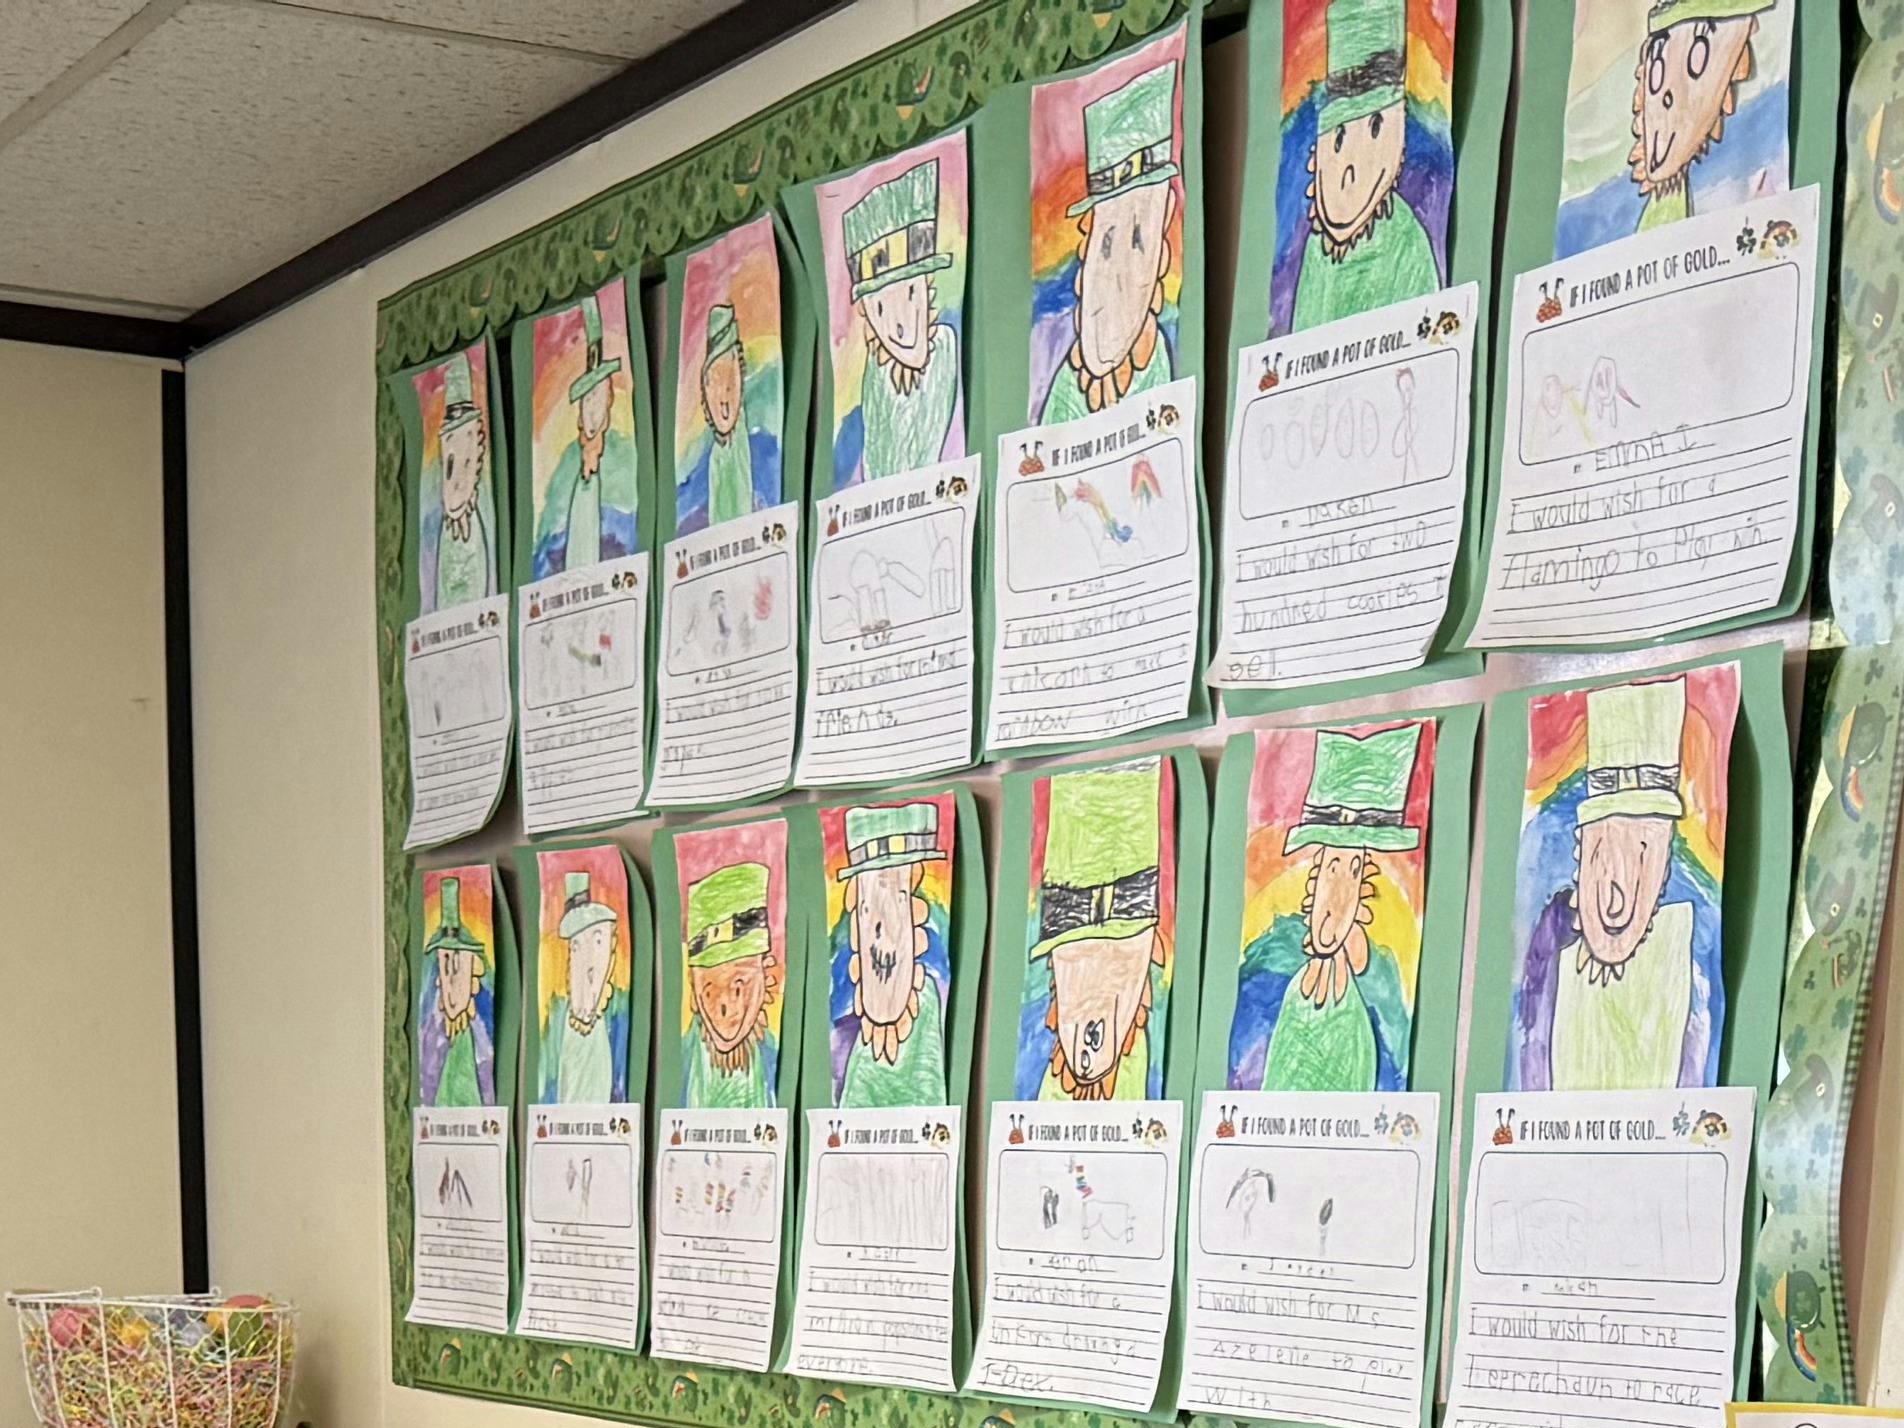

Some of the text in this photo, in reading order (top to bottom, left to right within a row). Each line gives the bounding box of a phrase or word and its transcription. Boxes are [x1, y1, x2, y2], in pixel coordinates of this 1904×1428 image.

[1570, 286, 1579, 308] IF
[1589, 272, 1622, 303] FOUND
[1625, 268, 1633, 291] A
[1637, 259, 1658, 288] POT
[1663, 254, 1679, 280] OF
[1684, 244, 1731, 275] GOLD...
[1520, 1120, 1529, 1141] IF
[1538, 1120, 1571, 1141] FOUND
[1575, 1120, 1583, 1141] A
[1586, 1120, 1605, 1141] POT
[1609, 1120, 1622, 1141] OF
